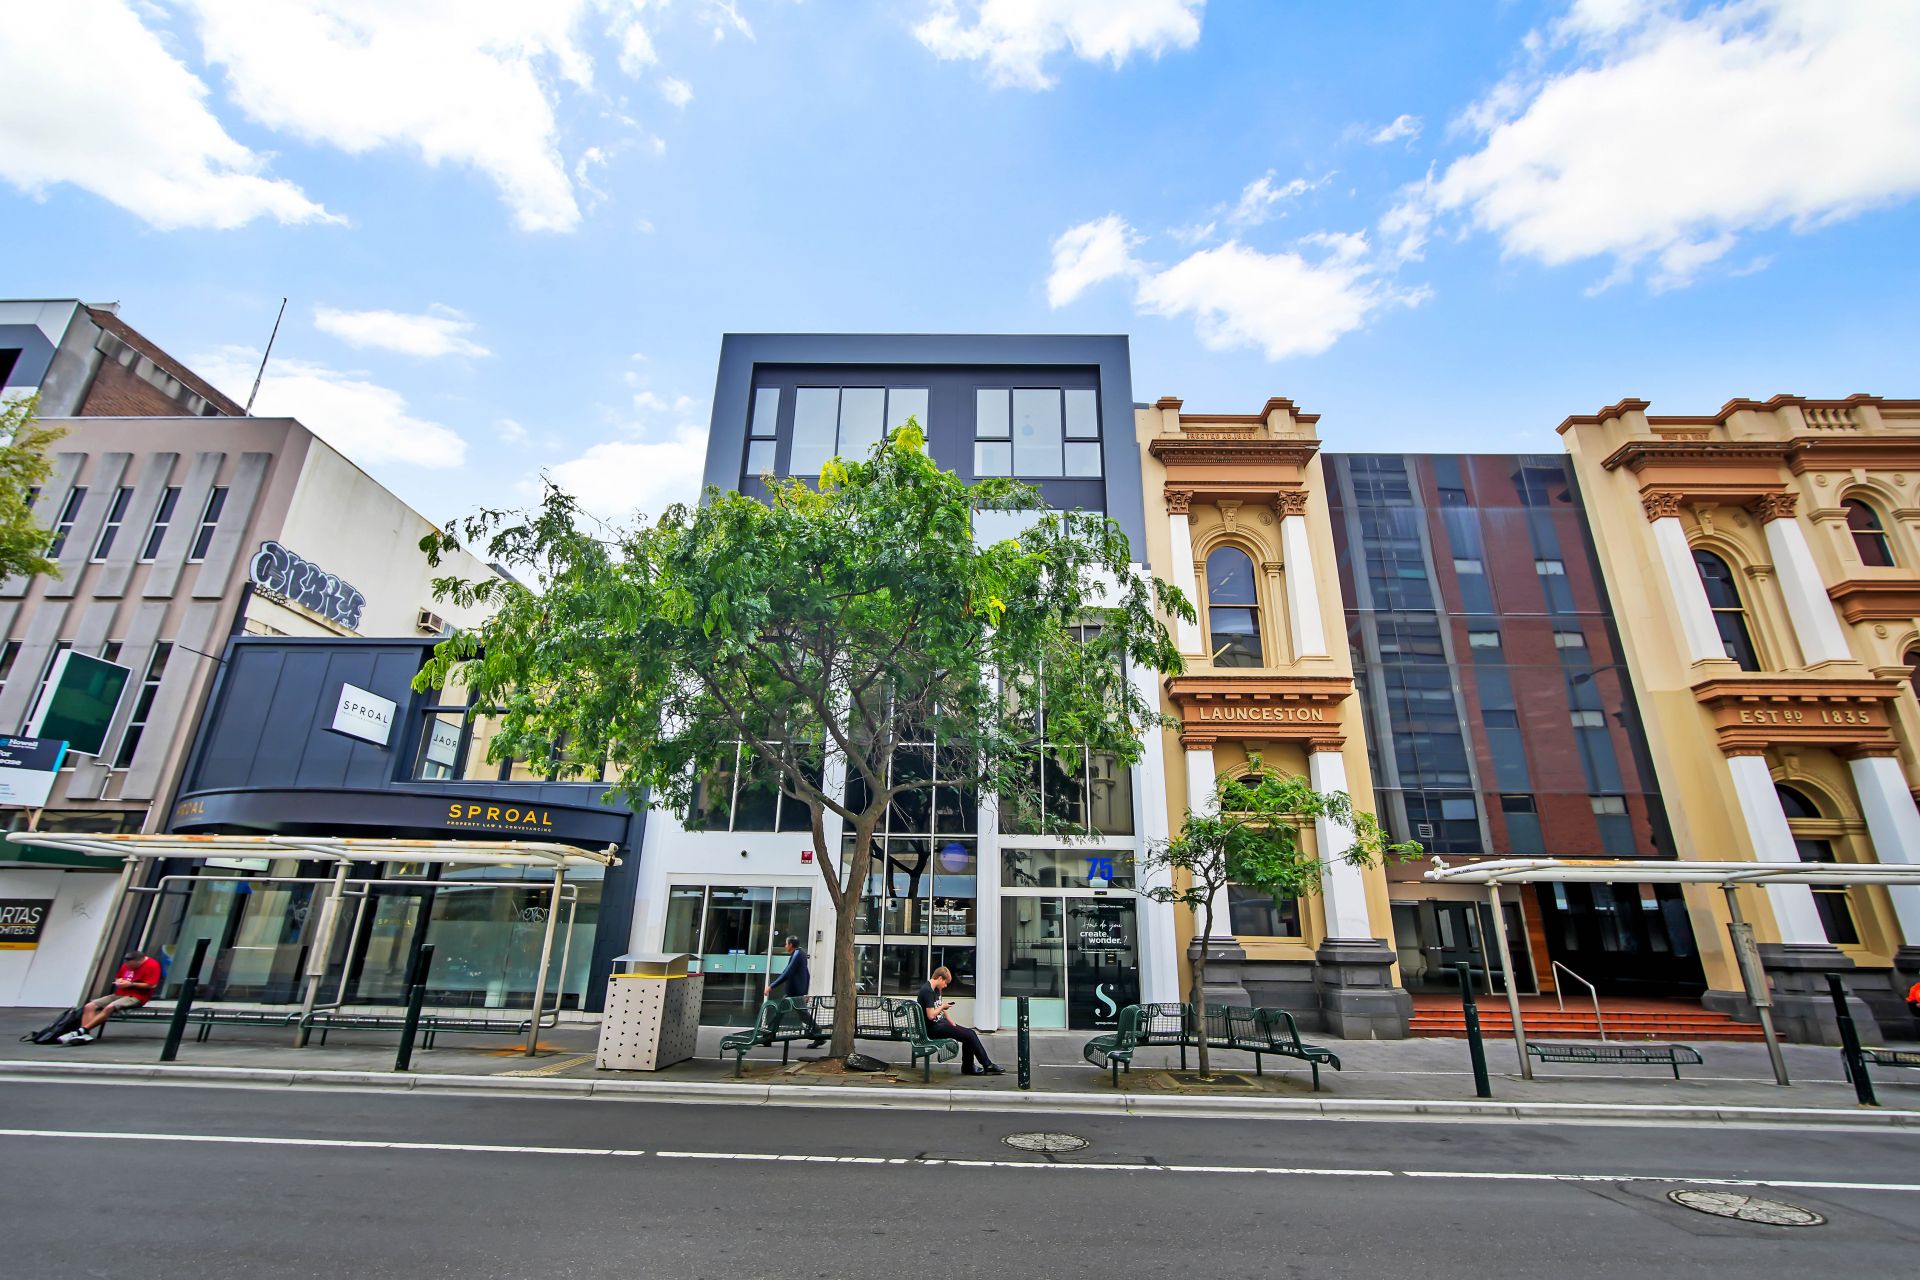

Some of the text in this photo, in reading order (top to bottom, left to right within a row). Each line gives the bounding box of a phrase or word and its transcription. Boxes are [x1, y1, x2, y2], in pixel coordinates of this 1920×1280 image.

[343, 700, 388, 724] SPROAL
[1199, 706, 1324, 721] LAUNCESTON
[1820, 710, 1870, 724] 1835
[8, 738, 39, 748] Howell
[448, 803, 553, 826] SPROAL
[446, 820, 480, 828] PROPERTY
[1086, 857, 1114, 881] 75
[1108, 923, 1123, 932] you
[1079, 930, 1109, 938] create.
[1088, 936, 1122, 944] wonder.
